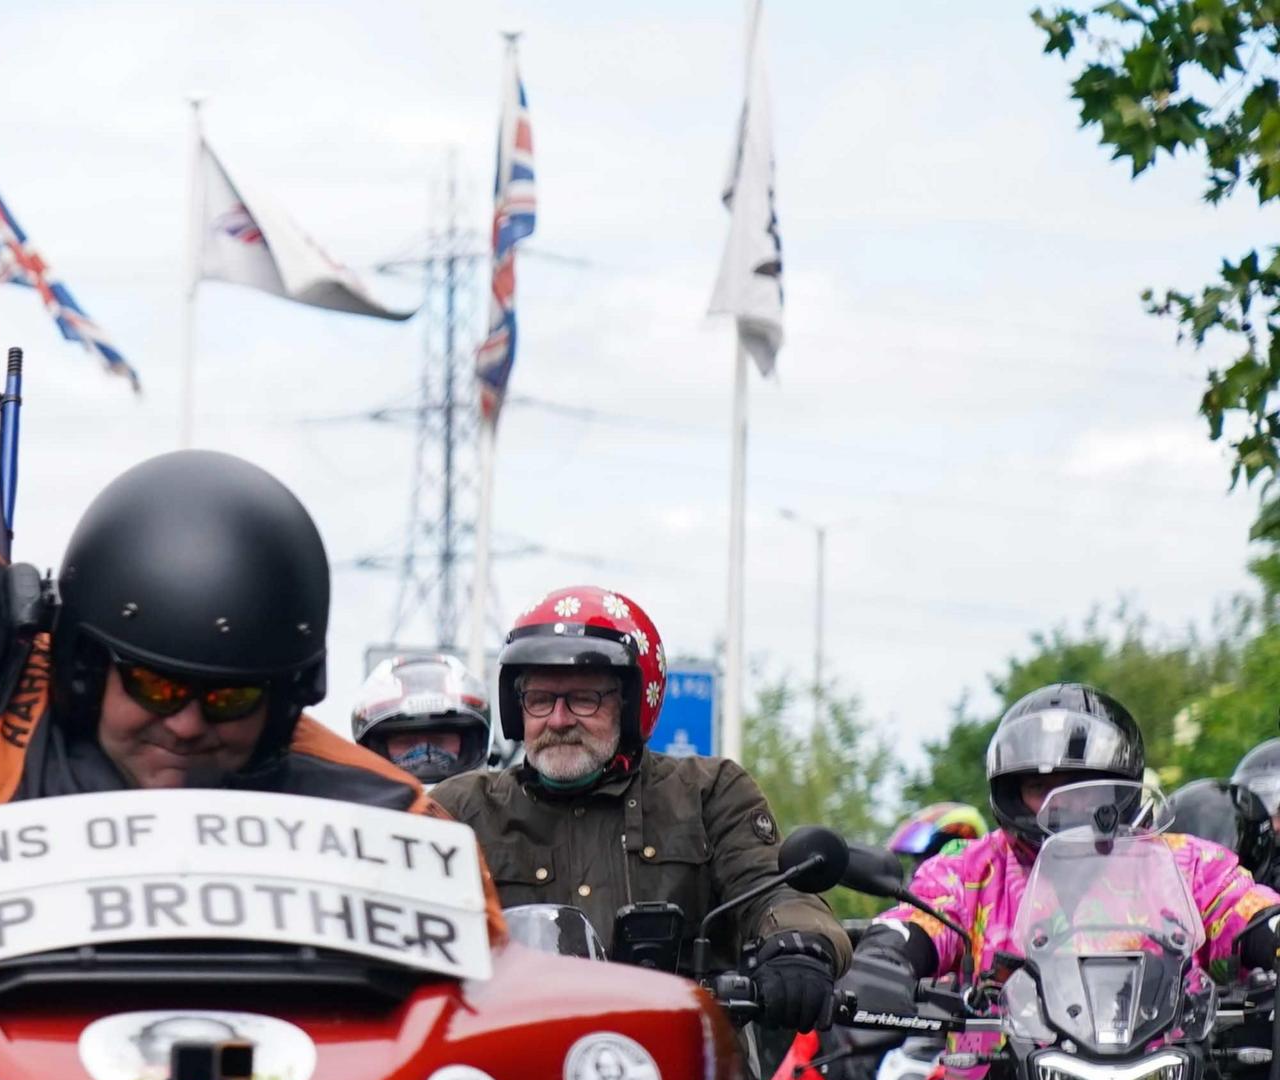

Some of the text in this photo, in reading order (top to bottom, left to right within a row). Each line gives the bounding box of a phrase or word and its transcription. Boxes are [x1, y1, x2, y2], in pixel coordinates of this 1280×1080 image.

[86, 814, 157, 850] OF
[194, 813, 460, 877] ROYALTY
[86, 881, 459, 966] BROTHER
[852, 1009, 943, 1032] Barkbusters
